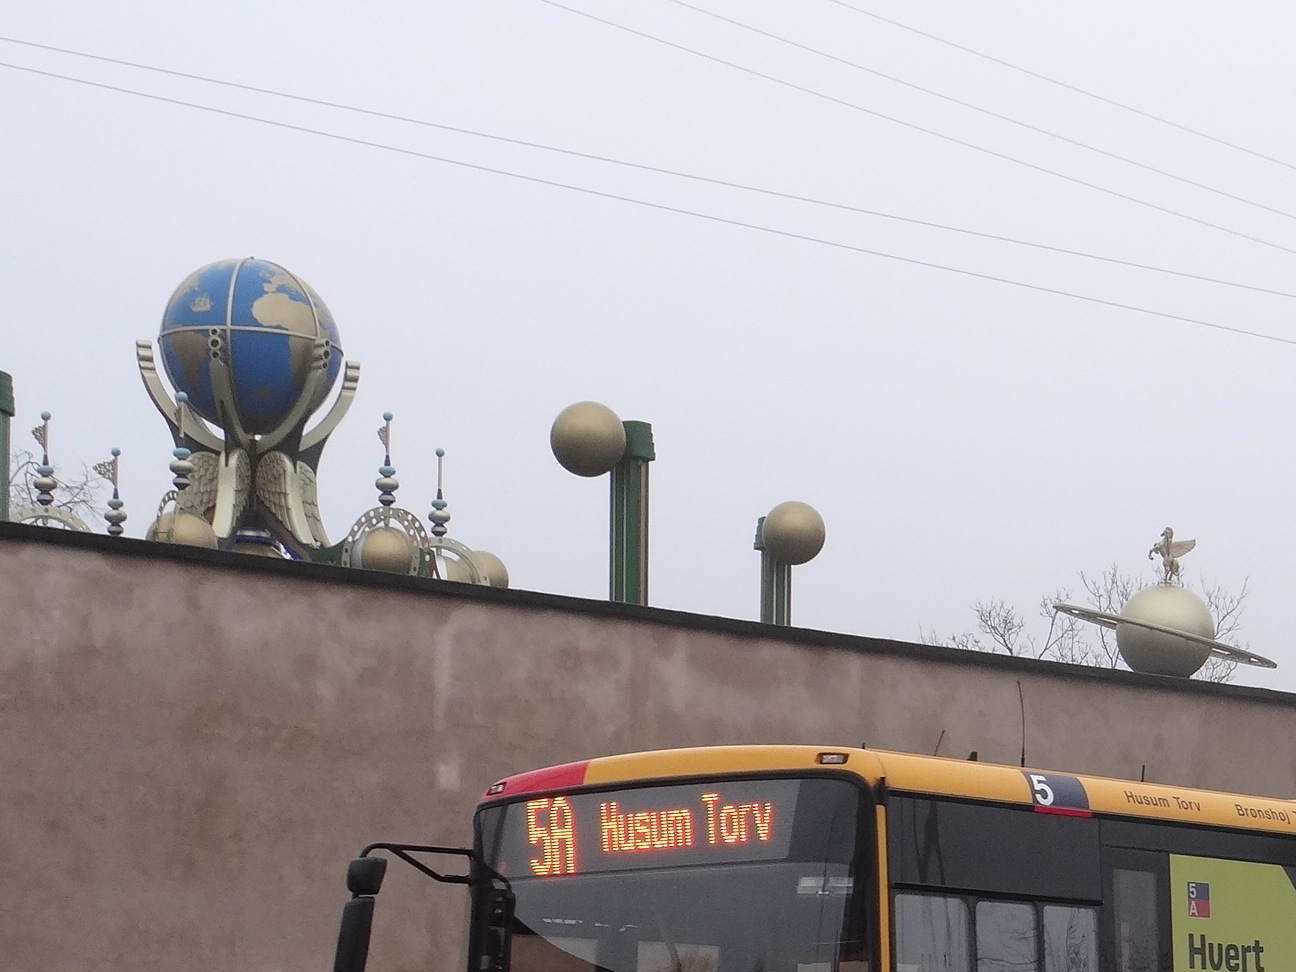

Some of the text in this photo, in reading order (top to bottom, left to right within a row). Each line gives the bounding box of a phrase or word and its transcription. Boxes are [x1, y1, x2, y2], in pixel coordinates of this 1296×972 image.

[1030, 774, 1054, 806] 5
[1123, 790, 1201, 812] Husum Torv
[1234, 804, 1291, 825] Brønshøj
[526, 793, 771, 876] 5A Husum Torv
[1189, 883, 1197, 898] 5
[1189, 901, 1198, 916] A
